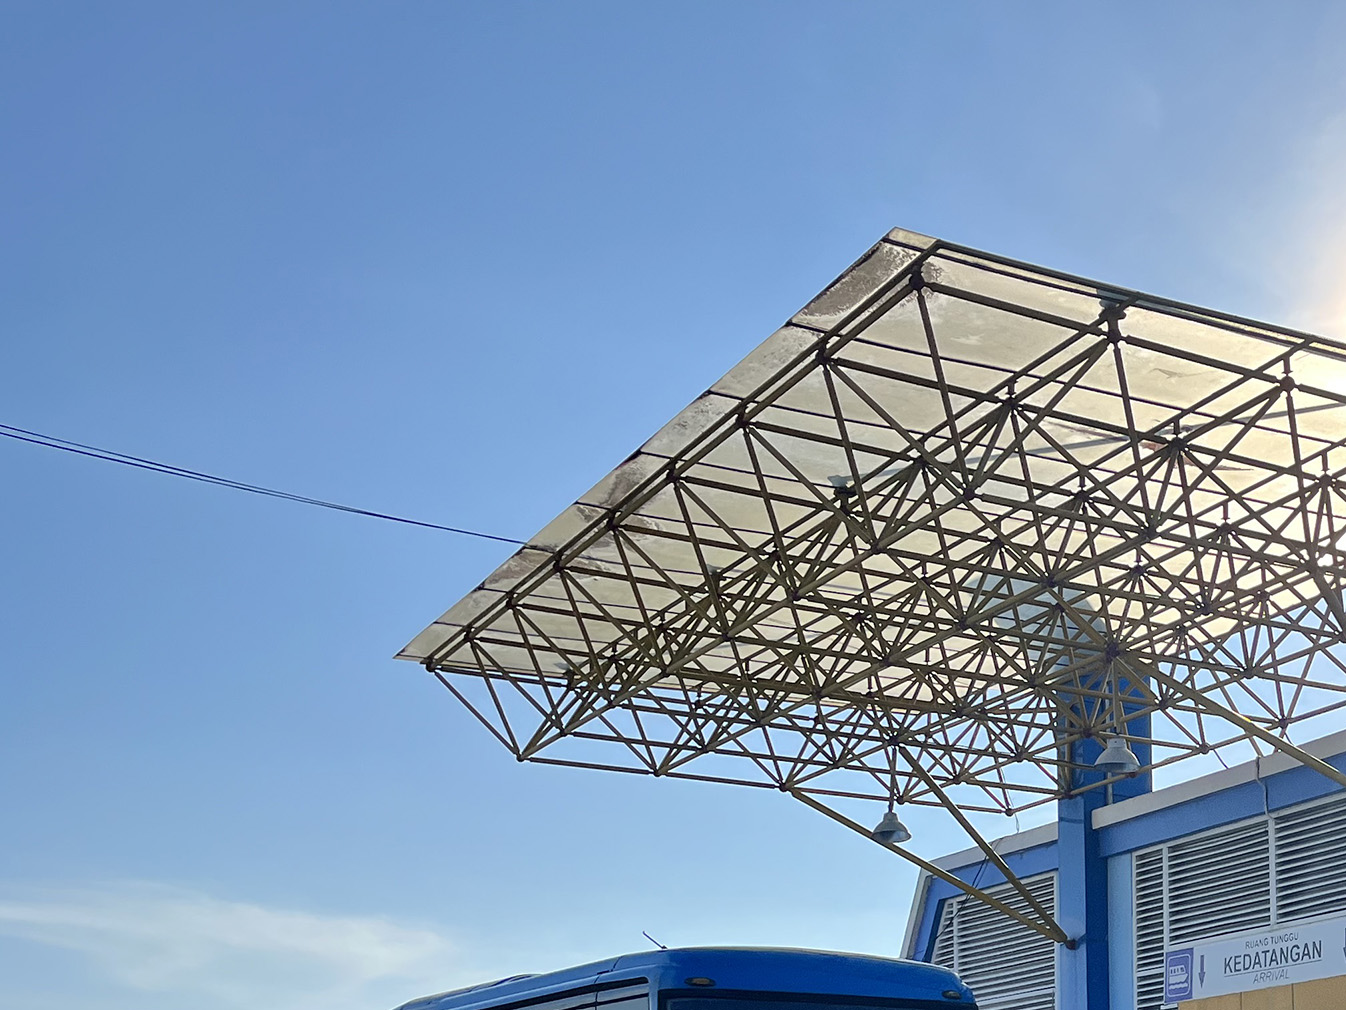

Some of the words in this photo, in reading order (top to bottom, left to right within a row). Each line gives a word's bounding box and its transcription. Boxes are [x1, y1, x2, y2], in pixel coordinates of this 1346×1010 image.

[1245, 937, 1269, 950] RUANG
[1271, 932, 1299, 945] TUNGGU
[1224, 940, 1322, 974] KEDATANGAN
[1253, 969, 1290, 984] ARRIVAL
